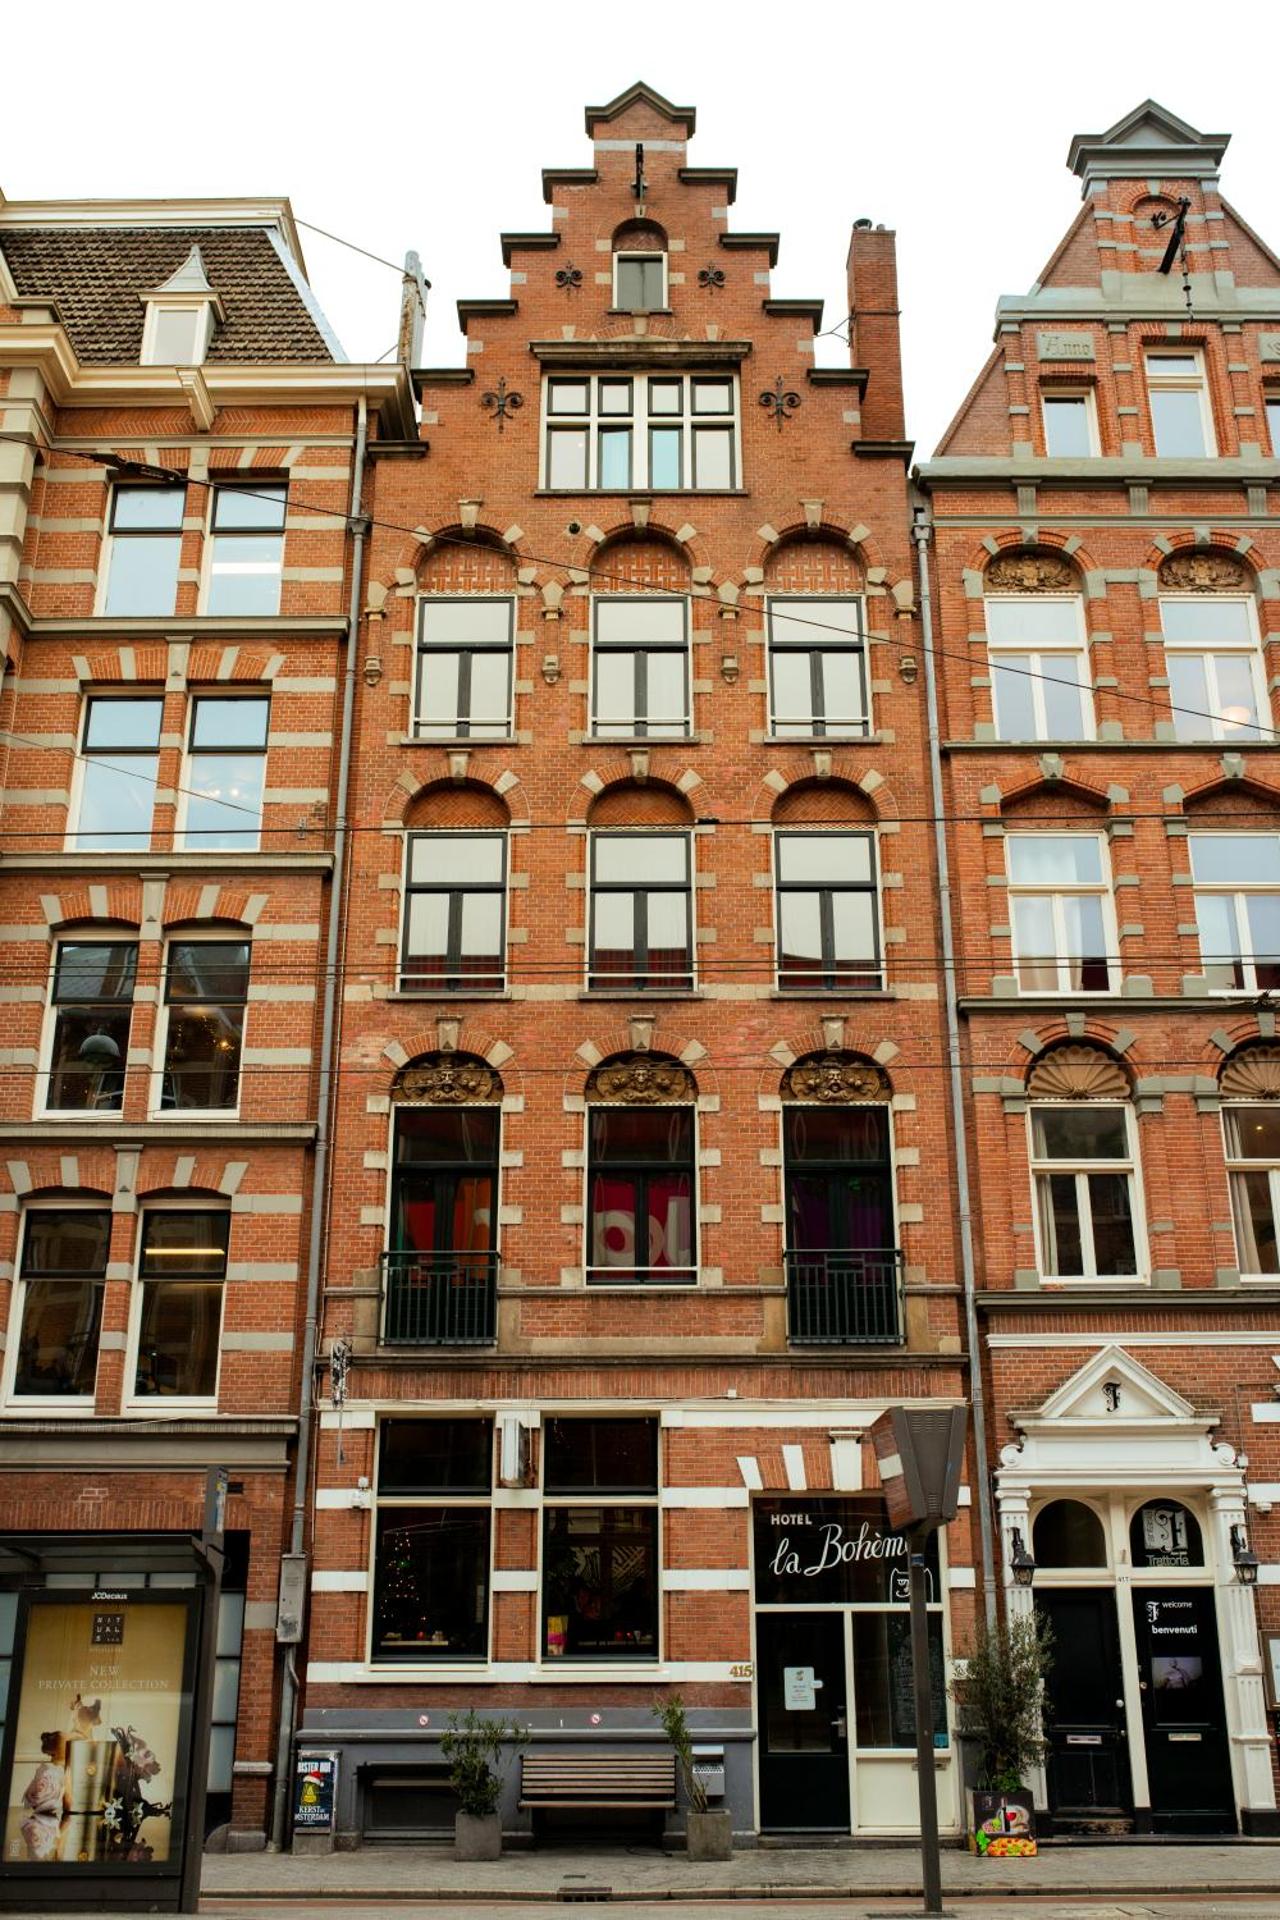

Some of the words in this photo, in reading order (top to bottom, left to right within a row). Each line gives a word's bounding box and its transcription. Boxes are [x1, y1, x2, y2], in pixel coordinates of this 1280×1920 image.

[771, 1514, 812, 1525] HOTEL
[769, 1537, 802, 1576] la
[91, 1591, 128, 1600] JCDecaux
[1151, 1624, 1198, 1634] benvenuti
[89, 1665, 120, 1676] NEW
[730, 1665, 752, 1678] 415
[38, 1679, 87, 1689] PRIVATE
[90, 1679, 169, 1689] COLLECTION
